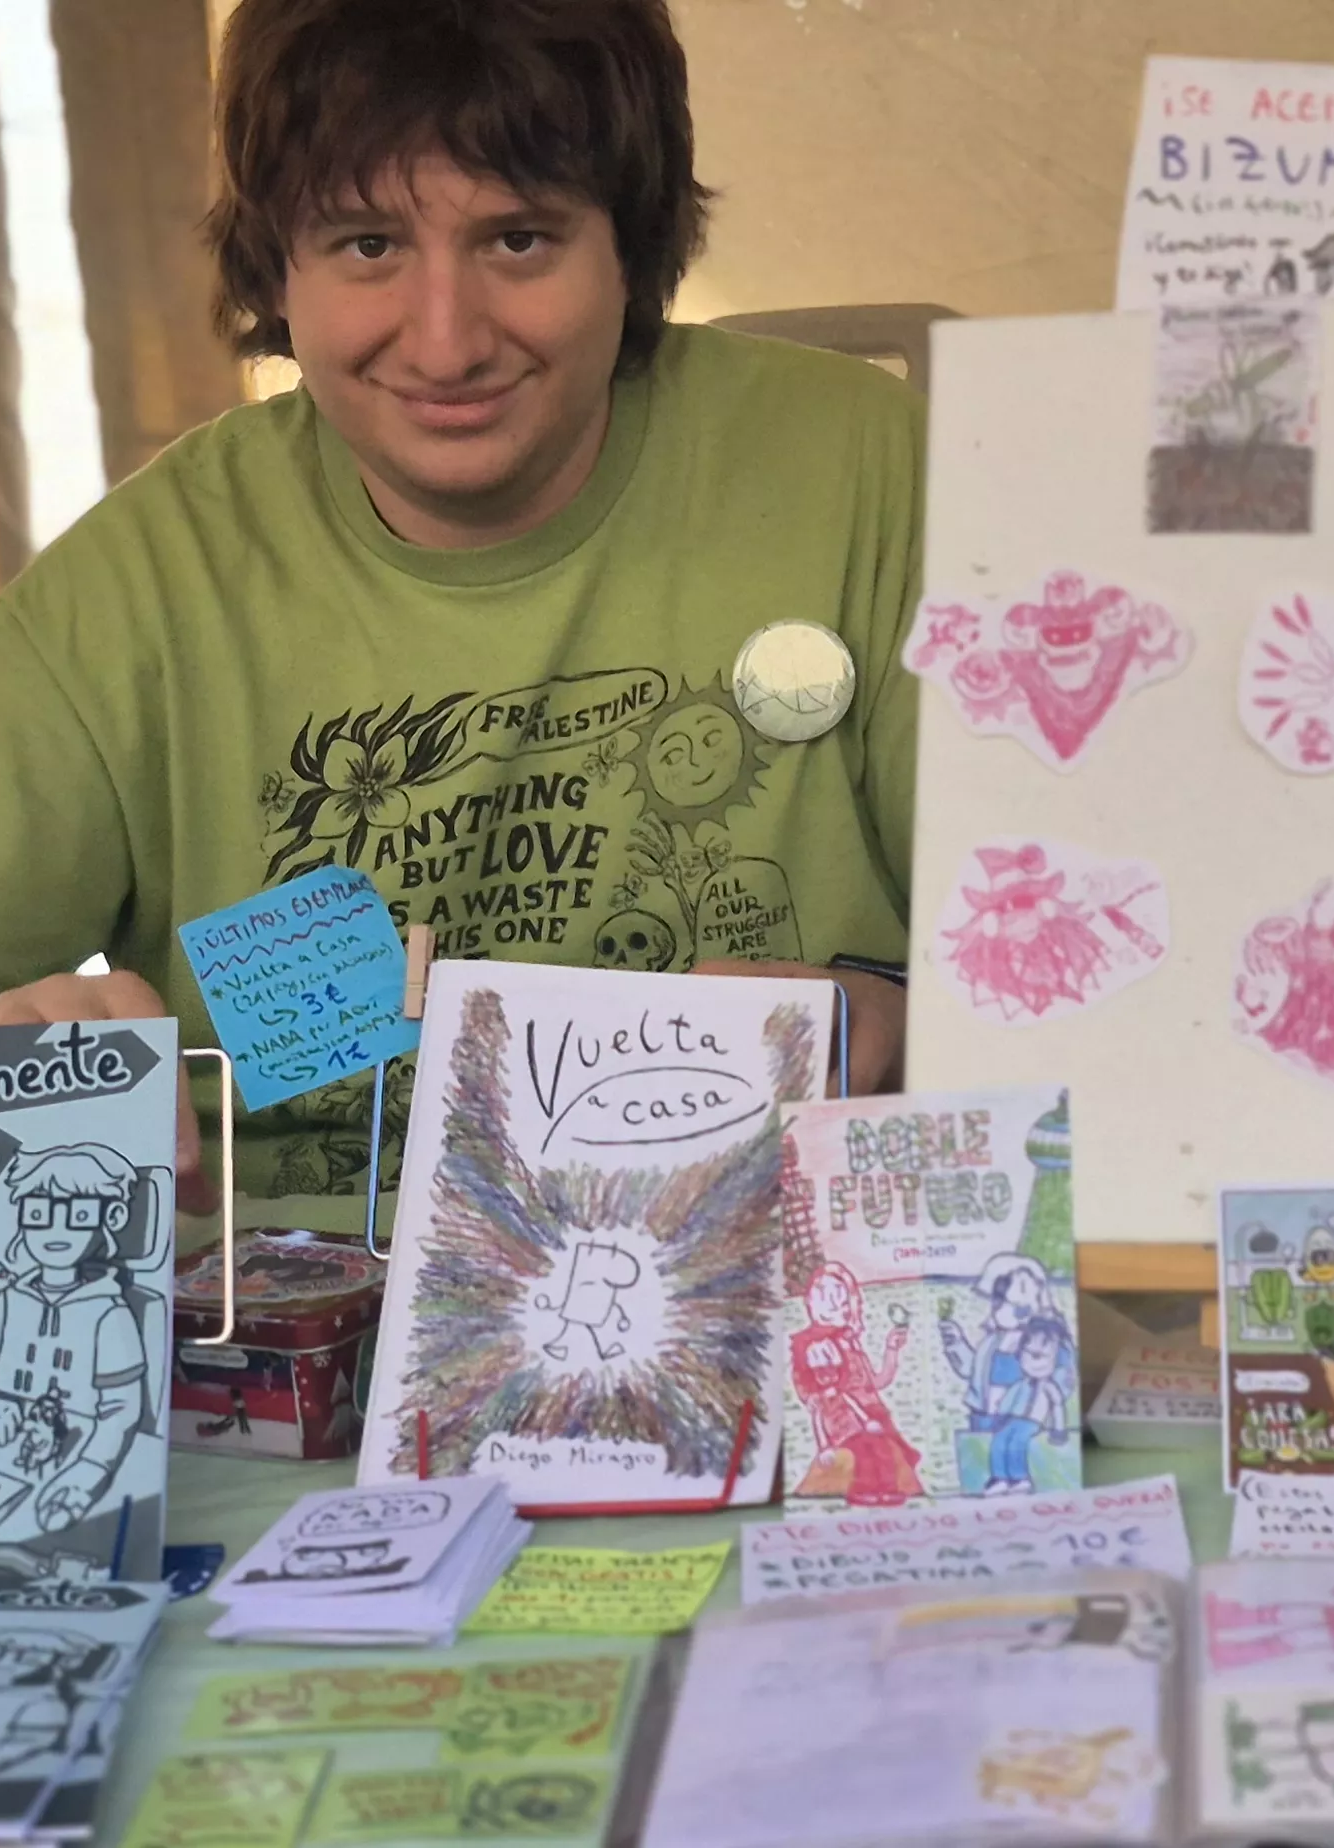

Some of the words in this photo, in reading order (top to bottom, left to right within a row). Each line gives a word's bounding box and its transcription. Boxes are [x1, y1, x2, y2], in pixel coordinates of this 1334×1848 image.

[374, 773, 590, 872] ANYTHING
[401, 845, 477, 889] BUT
[480, 821, 609, 880] LOVE
[424, 896, 454, 925] A
[462, 878, 594, 919] WASTE
[706, 877, 748, 903] ALL
[715, 895, 764, 919] OUR
[434, 922, 483, 953] HIS
[494, 917, 569, 945] ONE
[702, 904, 789, 941] STRUGGLES
[727, 932, 767, 954] ARE
[526, 1008, 730, 1120] Vuelta
[587, 1094, 609, 1109] a
[622, 1089, 733, 1126] casa
[489, 1441, 553, 1472] Diego
